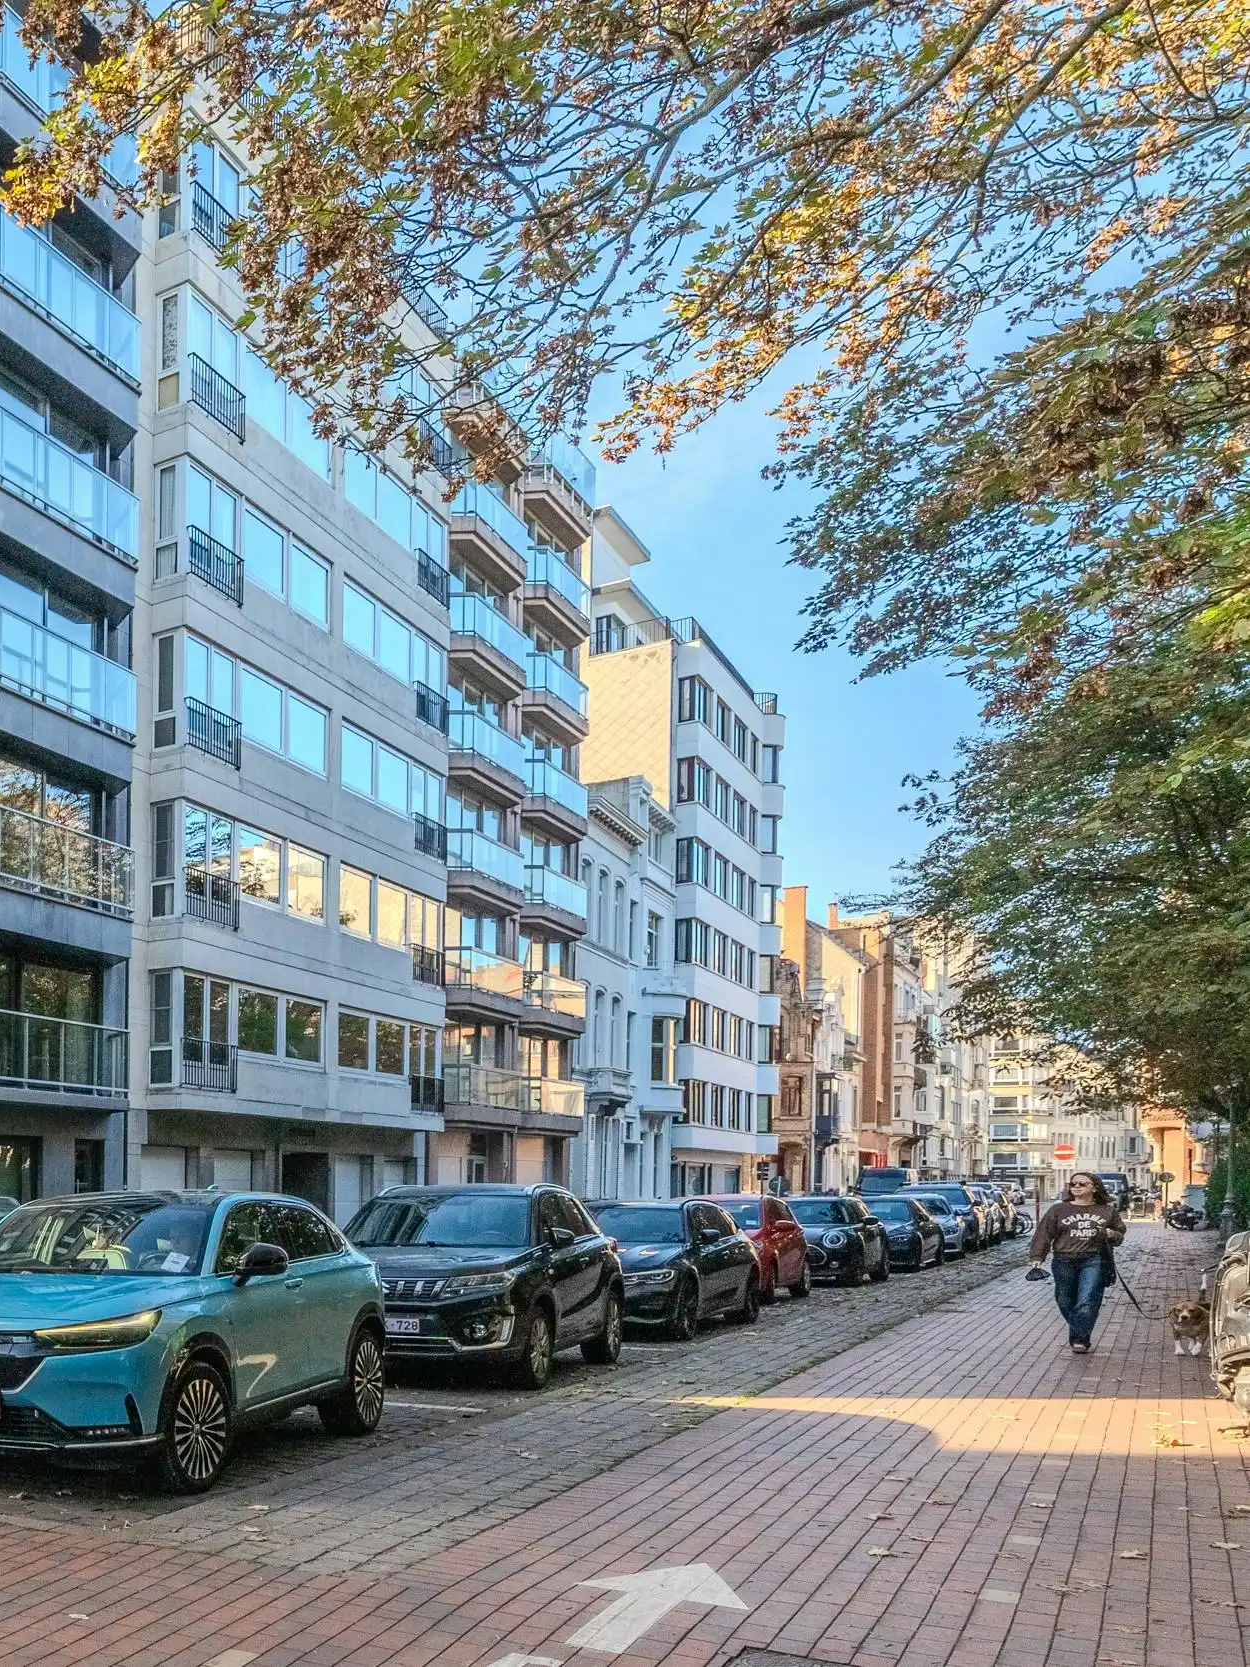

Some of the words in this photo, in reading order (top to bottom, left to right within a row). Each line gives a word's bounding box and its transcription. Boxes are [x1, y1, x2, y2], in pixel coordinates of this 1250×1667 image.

[1061, 1213, 1106, 1225] CHARME
[1078, 1220, 1091, 1229] DE
[1070, 1229, 1097, 1237] PARIS
